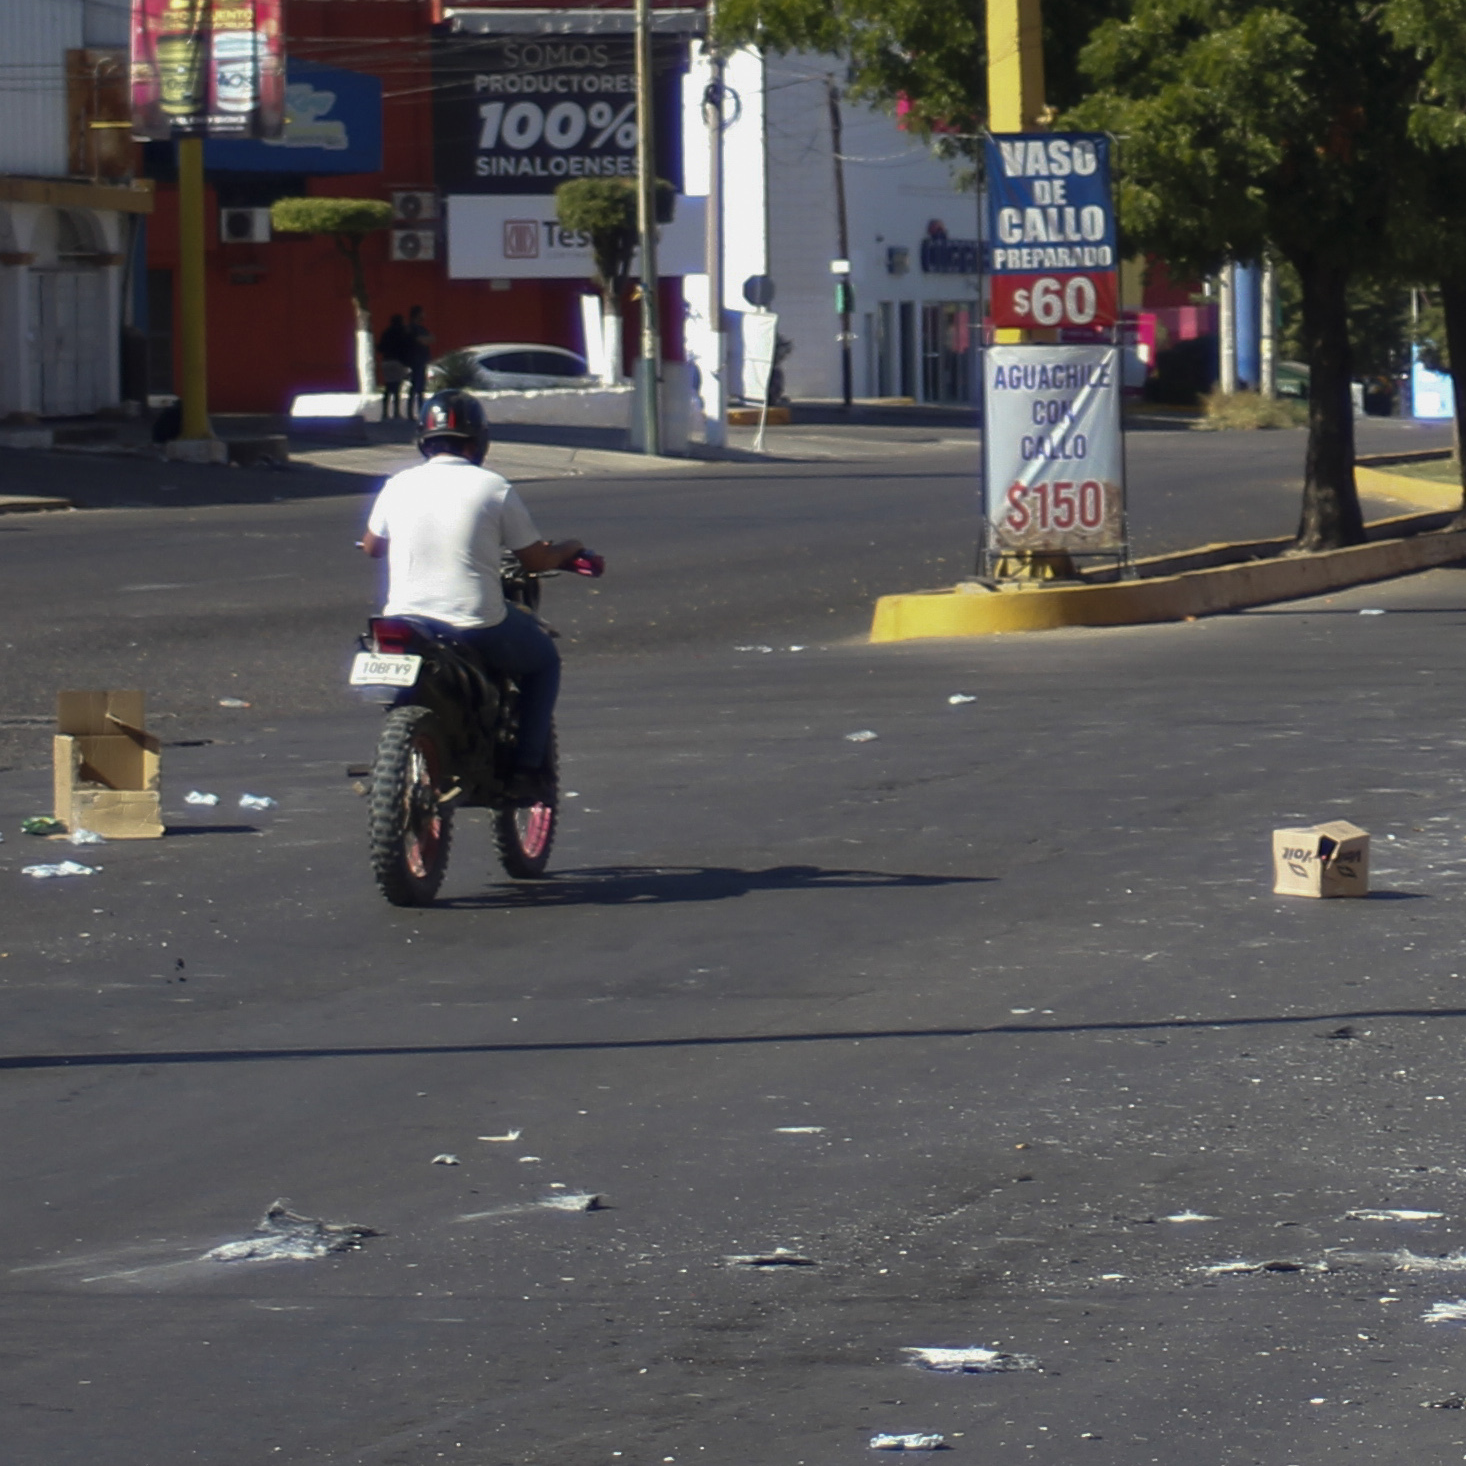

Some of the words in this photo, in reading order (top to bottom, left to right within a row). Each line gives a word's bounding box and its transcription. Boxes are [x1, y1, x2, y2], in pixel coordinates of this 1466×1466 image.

[504, 44, 609, 68] SOMOS
[479, 101, 638, 150] 100%
[1001, 139, 1098, 177] VASO
[1033, 179, 1067, 207] DE
[998, 206, 1105, 244] CALLO
[993, 246, 1113, 270] PREPARADO
[1014, 275, 1097, 327] $60
[994, 363, 1111, 391] AGUACHILE
[1032, 399, 1075, 425] CON
[1021, 434, 1087, 462] CALLO
[1007, 480, 1104, 532] $150
